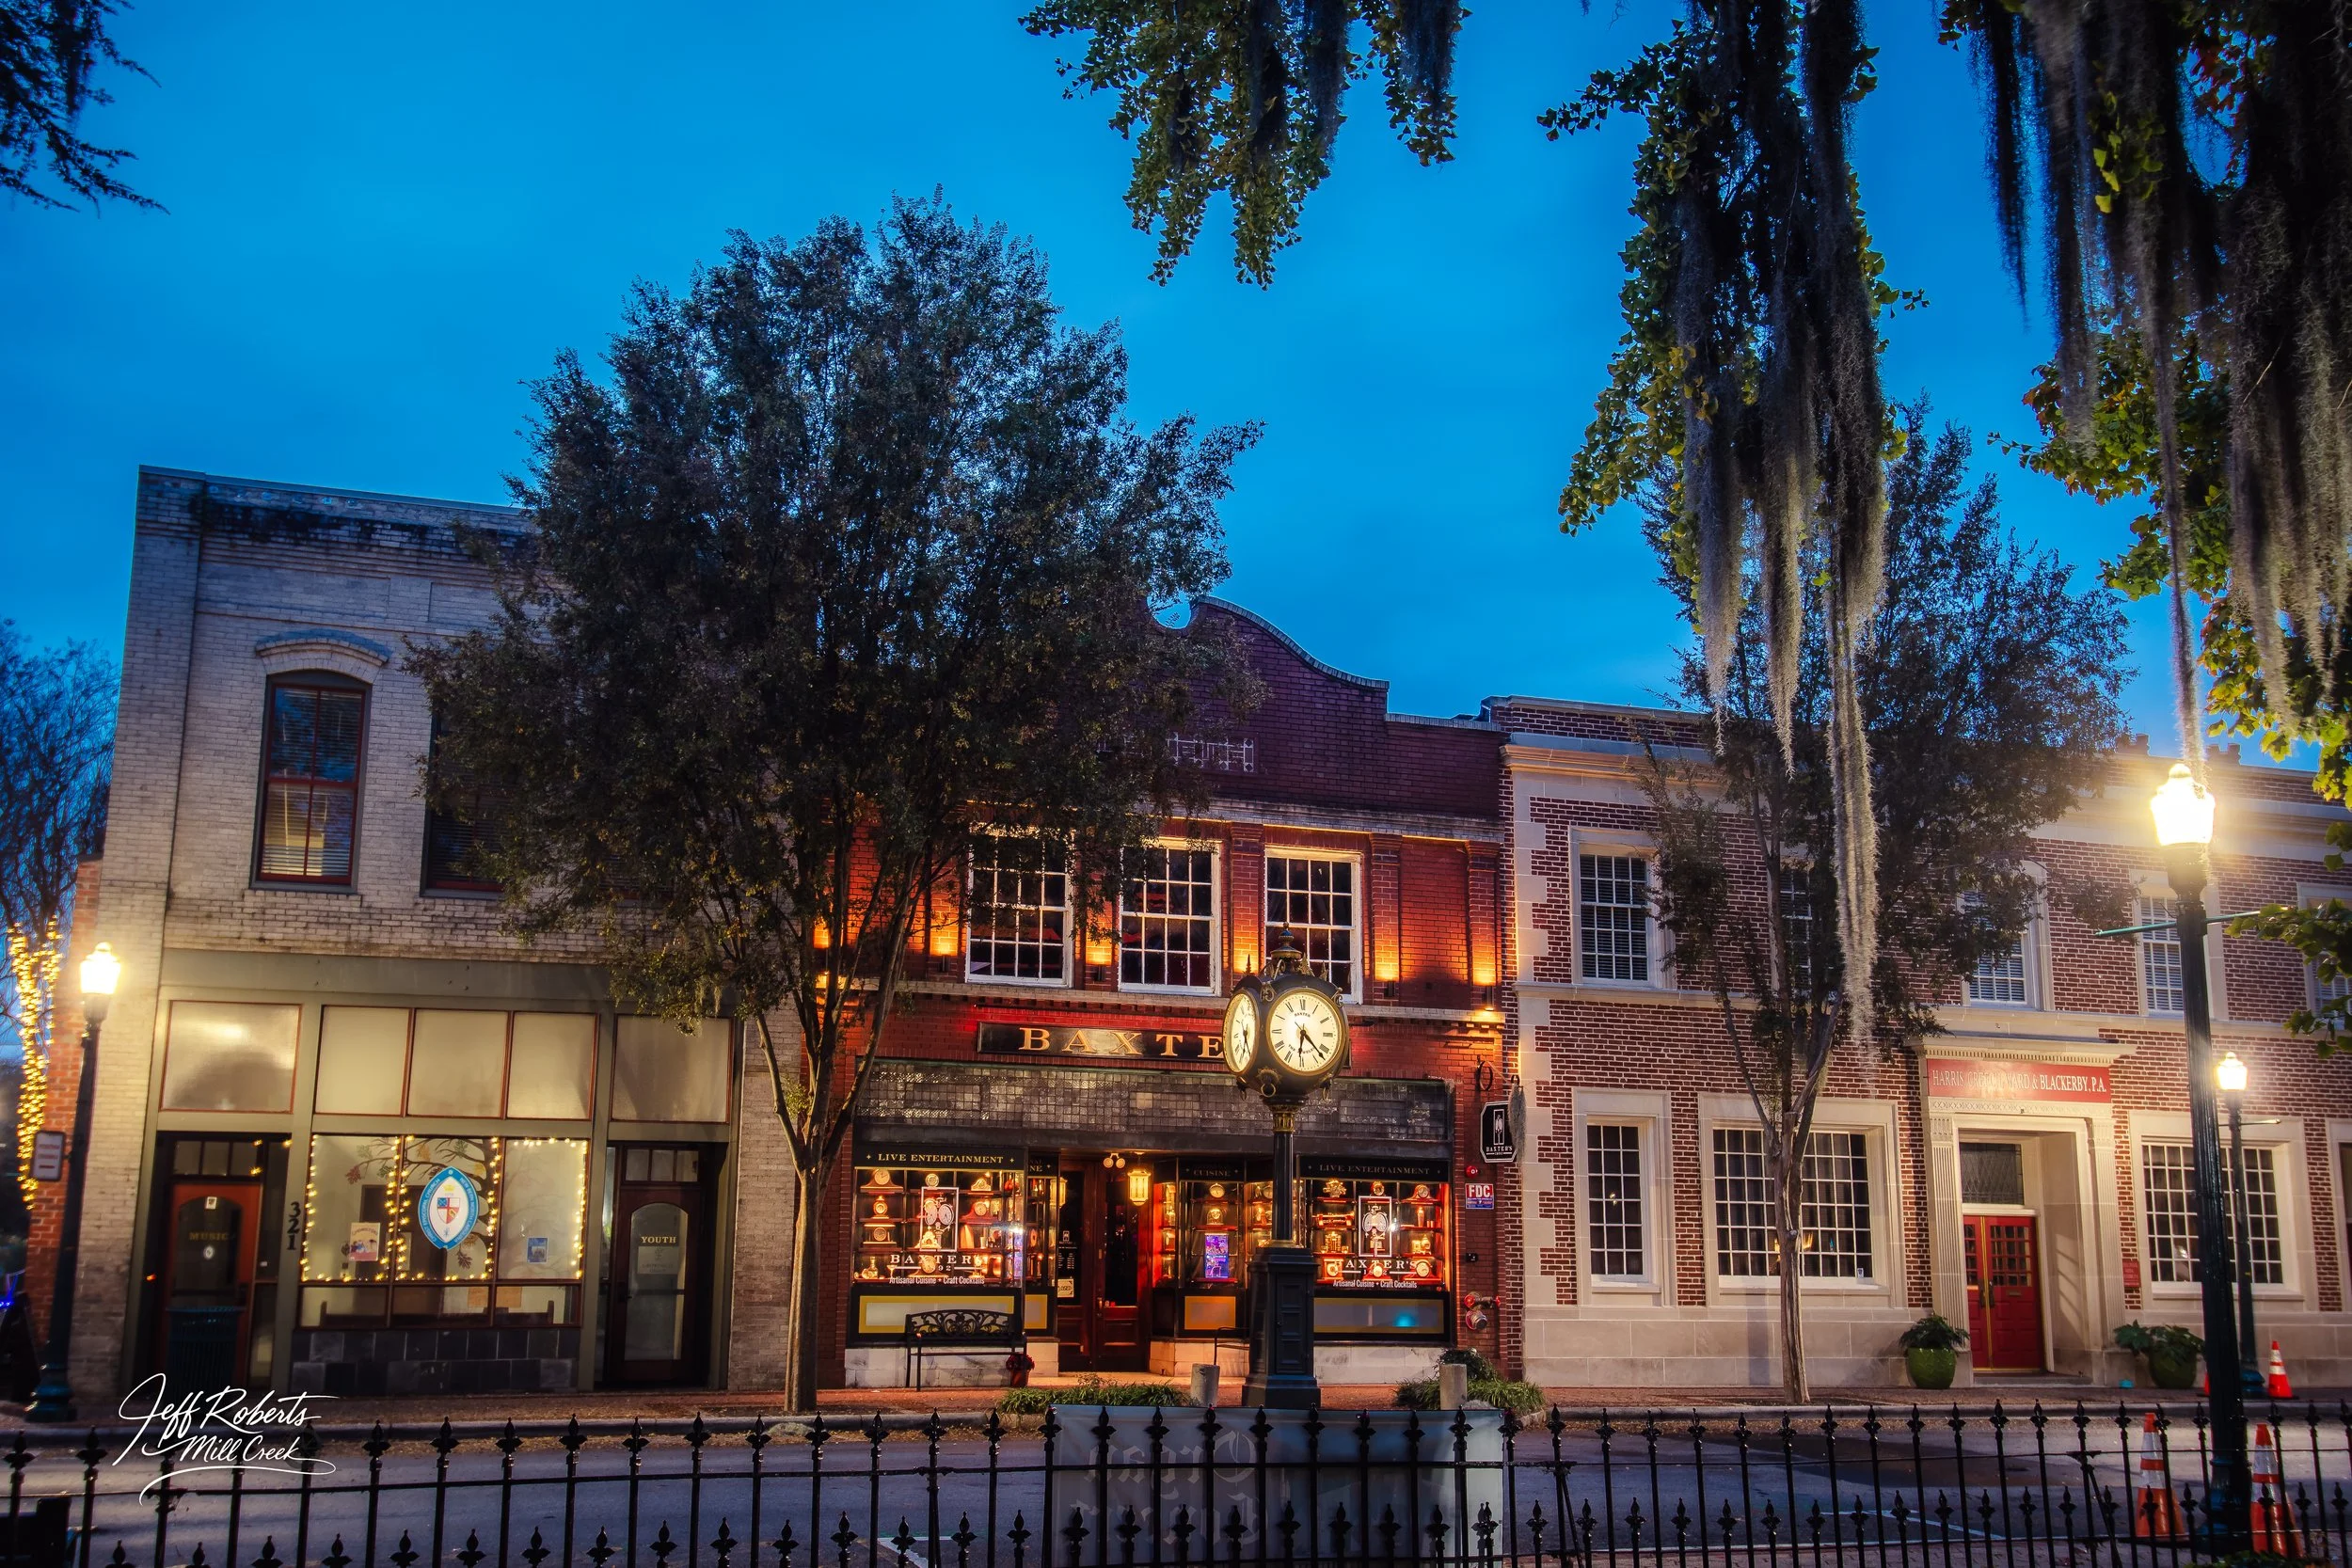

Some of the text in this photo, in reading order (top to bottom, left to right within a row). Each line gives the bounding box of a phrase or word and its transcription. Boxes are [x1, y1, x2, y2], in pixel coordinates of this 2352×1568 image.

[2040, 1074, 2090, 1093] BLACKERBY,
[2091, 1076, 2107, 1092] P.A.
[878, 1153, 1004, 1164] LIVE ENTERTAINMENT
[1319, 1164, 1430, 1175] LIVE ENTERTAINMENT
[1469, 1184, 1491, 1197] FDC
[287, 1201, 301, 1251] 321
[189, 1231, 230, 1242] MUSIC
[889, 1275, 985, 1285] Artisanal Cuisine Craft Cocktails
[1332, 1279, 1356, 1288] Artisanal
[1356, 1279, 1375, 1288] Cuisine
[1393, 1280, 1418, 1289] Cocktails
